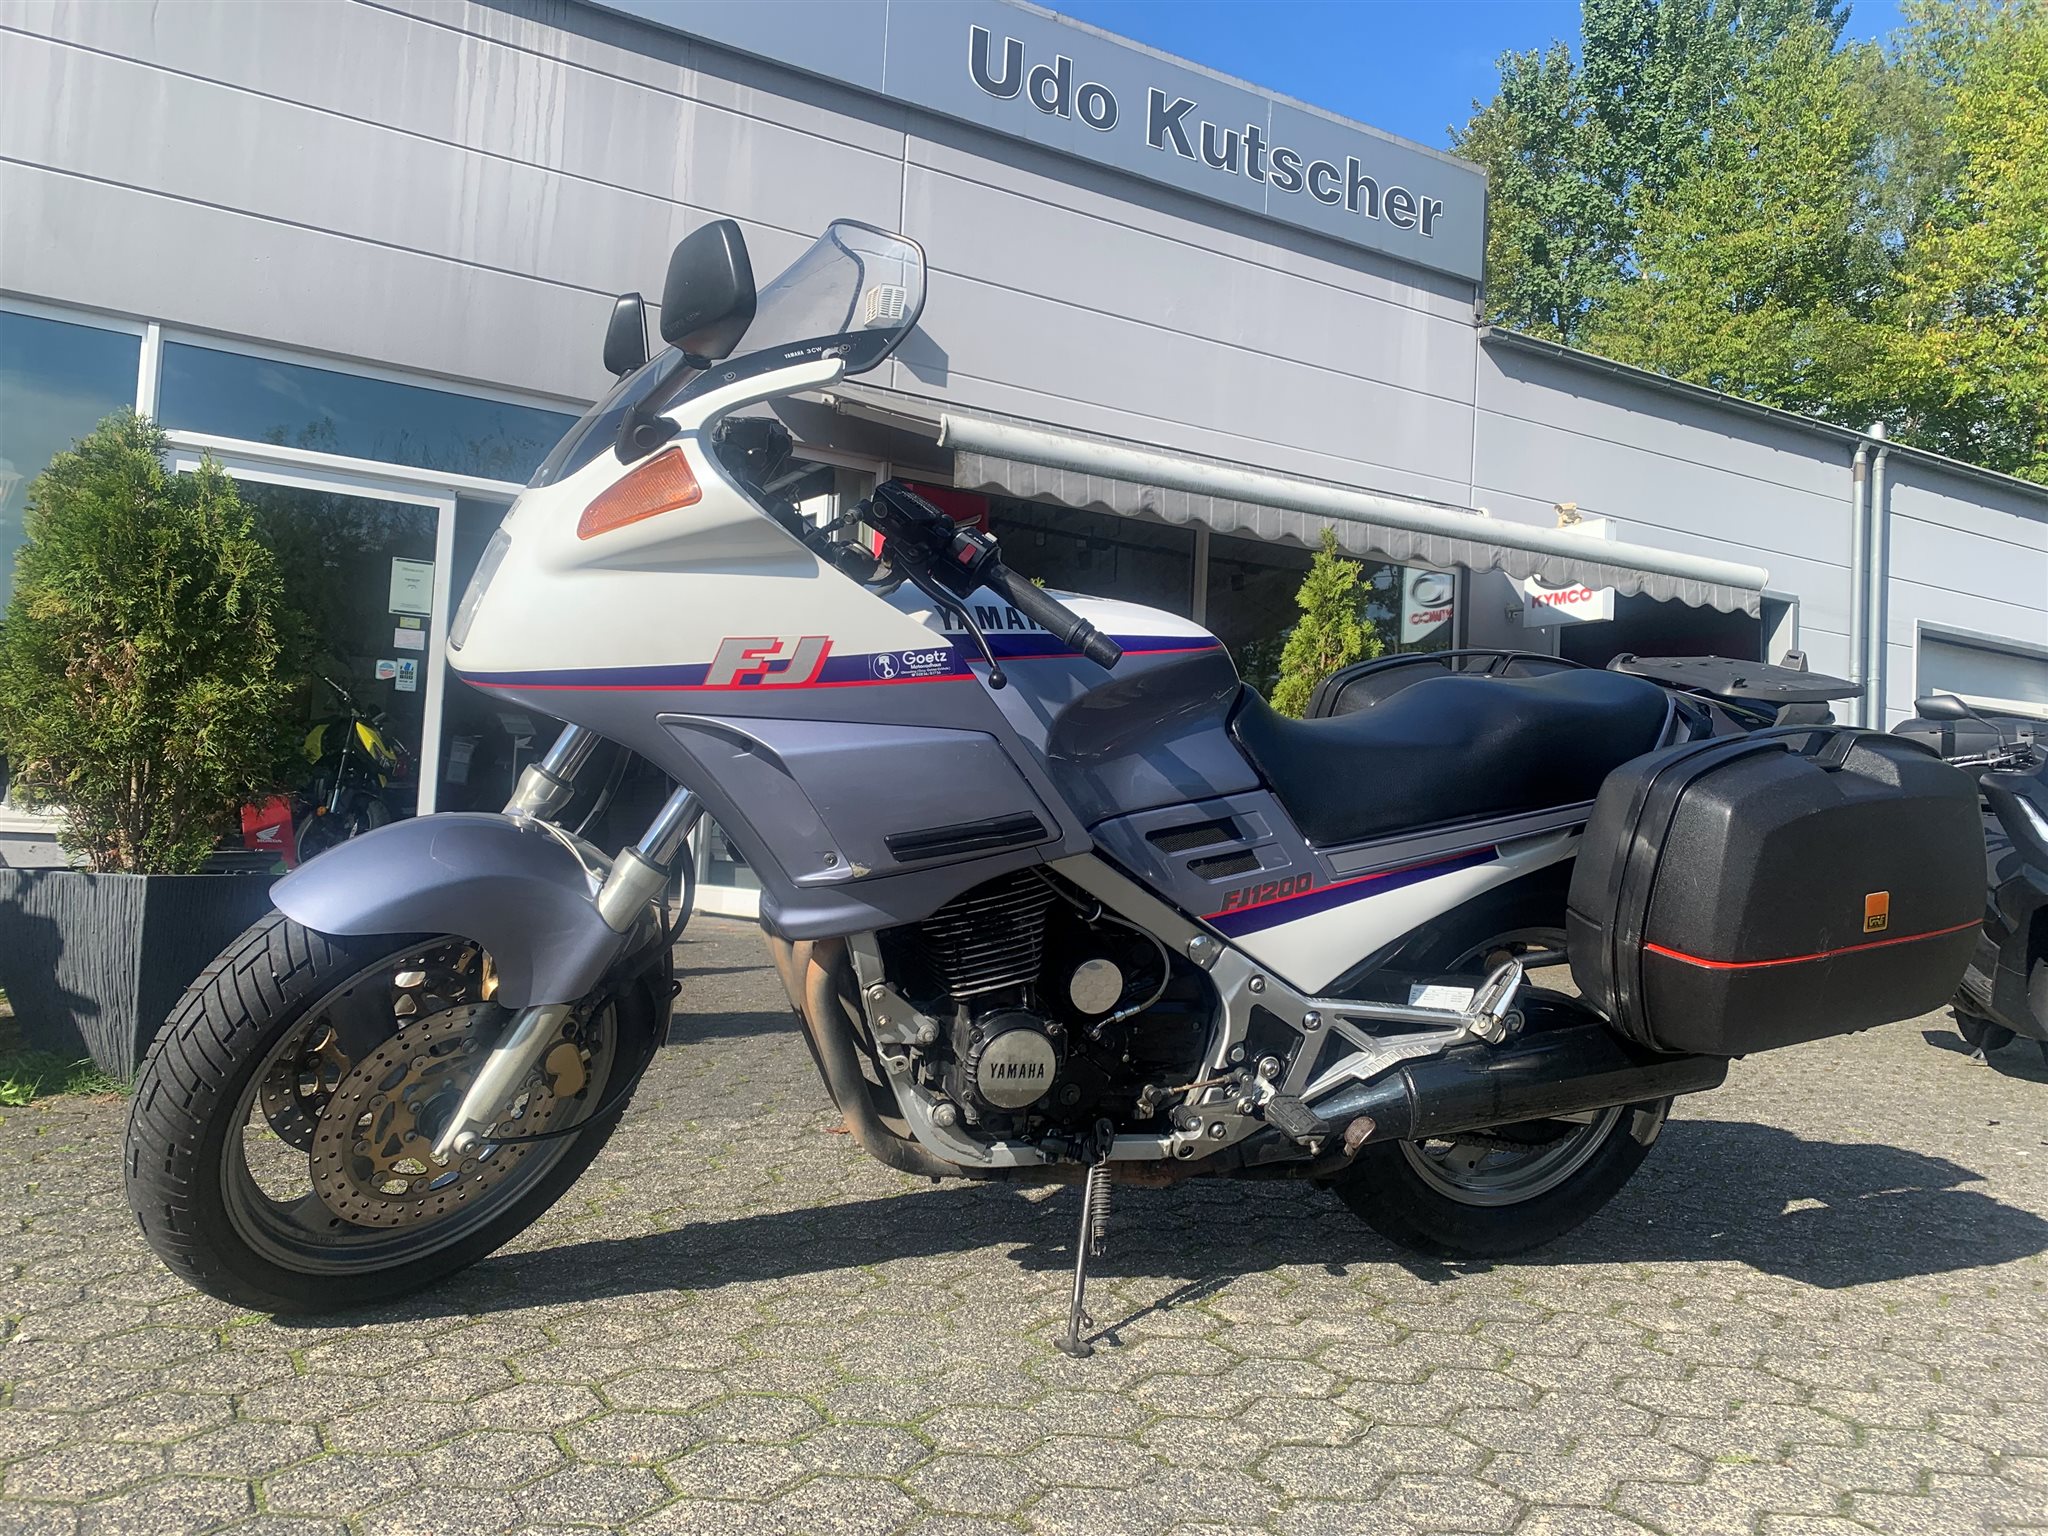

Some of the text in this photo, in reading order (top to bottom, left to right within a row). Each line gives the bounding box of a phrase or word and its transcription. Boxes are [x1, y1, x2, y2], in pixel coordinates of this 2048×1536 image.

[968, 23, 1443, 239] Udo Kutscher
[784, 346, 822, 359] YAMAHA 3CW
[1531, 588, 1592, 609] KYMCO
[702, 635, 834, 686] FJ
[902, 650, 947, 665] Goetz
[1220, 872, 1313, 912] FJ1200
[989, 1062, 1045, 1079] YAMAHA
